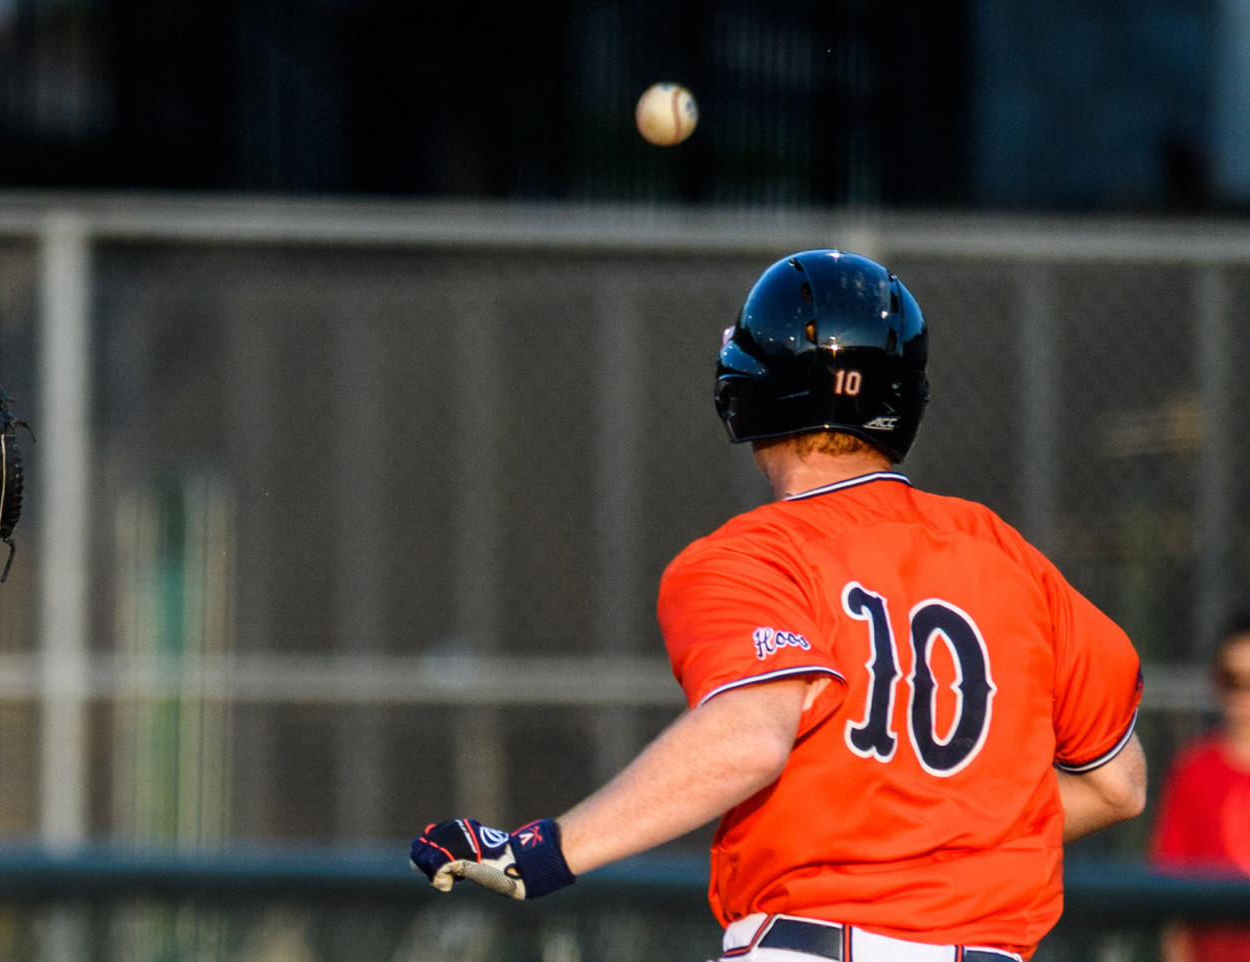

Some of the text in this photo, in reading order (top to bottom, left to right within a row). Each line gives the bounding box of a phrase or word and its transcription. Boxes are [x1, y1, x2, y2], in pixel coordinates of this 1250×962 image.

[834, 369, 862, 396] 10
[865, 417, 898, 429] ACC
[841, 581, 997, 777] 10
